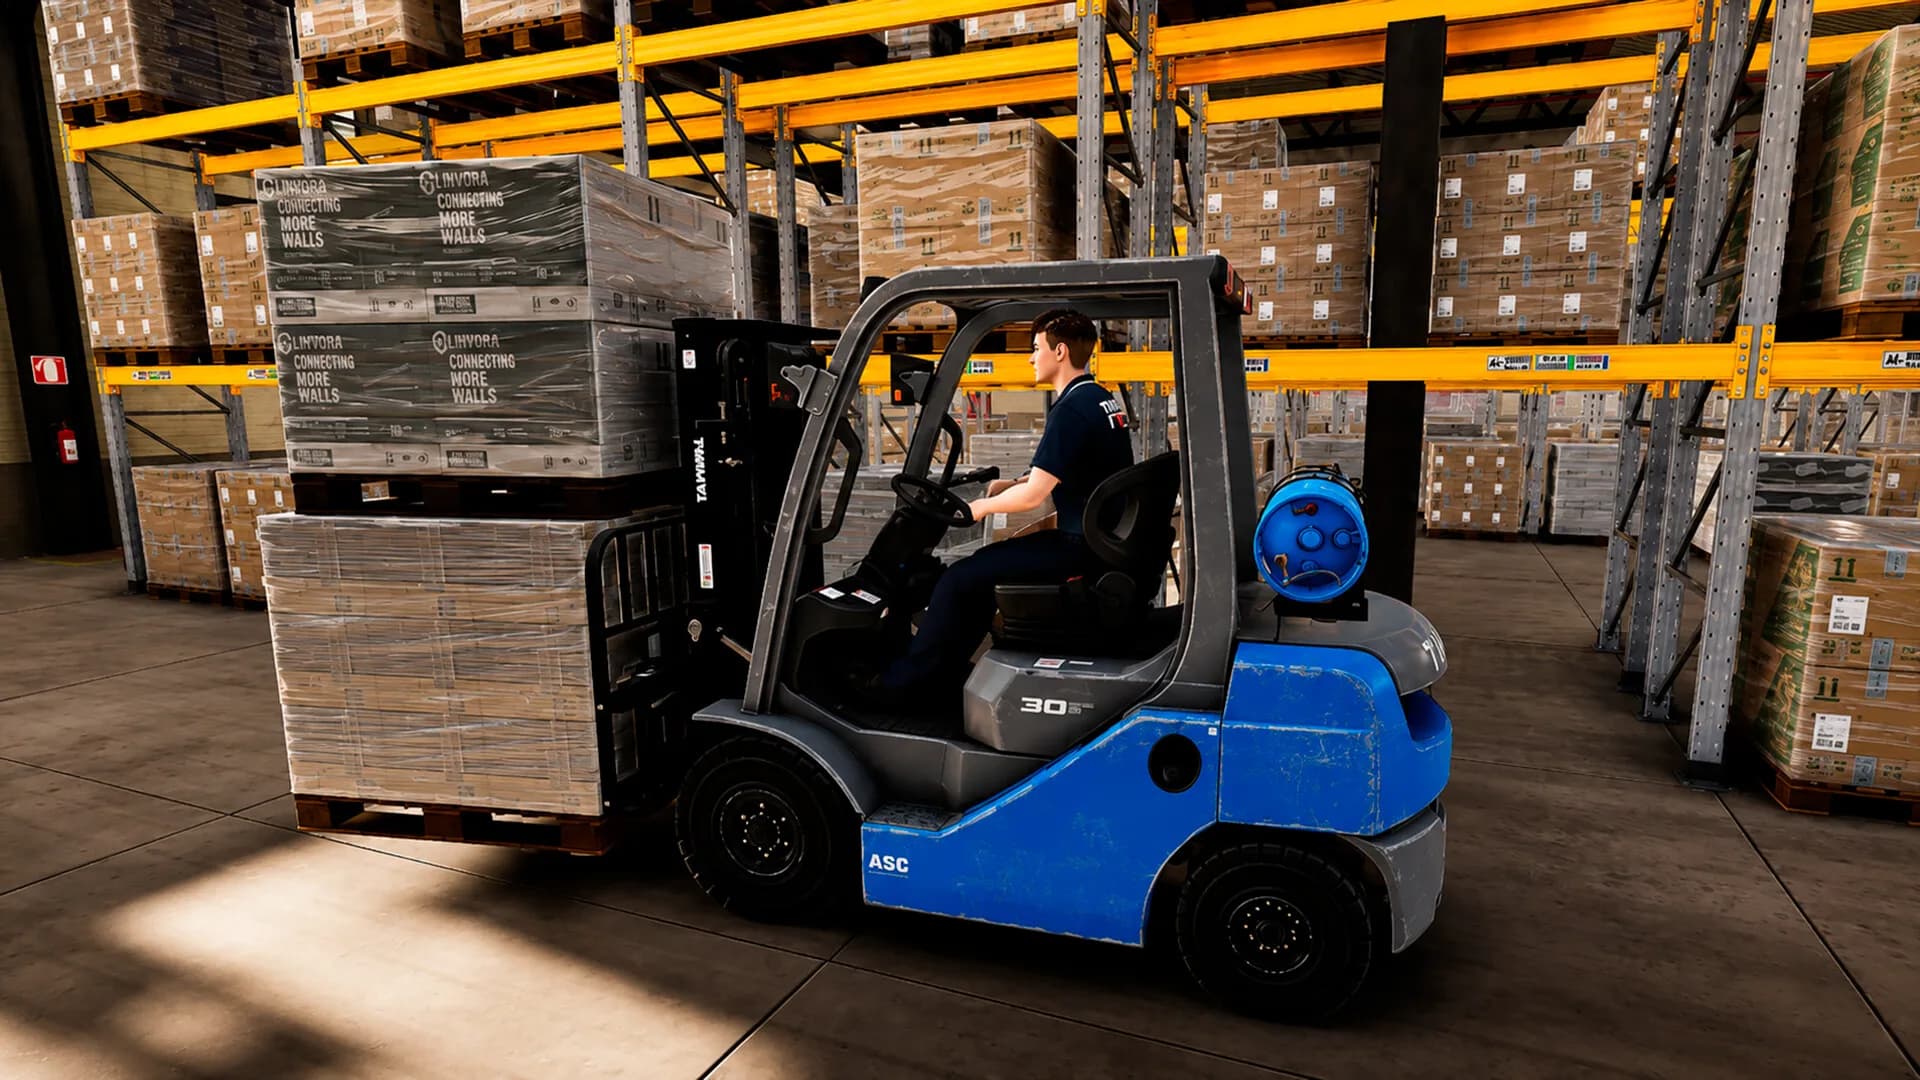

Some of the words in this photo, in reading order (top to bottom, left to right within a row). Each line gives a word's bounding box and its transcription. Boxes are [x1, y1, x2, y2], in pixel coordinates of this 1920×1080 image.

[277, 197, 341, 214] CONNECTING
[437, 191, 504, 209] CONNECTING
[280, 215, 316, 231] MORE
[439, 210, 476, 228] MORE
[281, 231, 324, 248] WALLS
[440, 227, 486, 245] WALLS
[294, 354, 355, 370] CONNECTING
[449, 353, 516, 369] CONNECTING
[296, 371, 331, 387] MORE
[450, 370, 488, 387] MORE
[298, 387, 340, 403] WALLS
[452, 387, 497, 404] WALLS
[1020, 697, 1067, 715] 30
[868, 853, 909, 873] ASC
